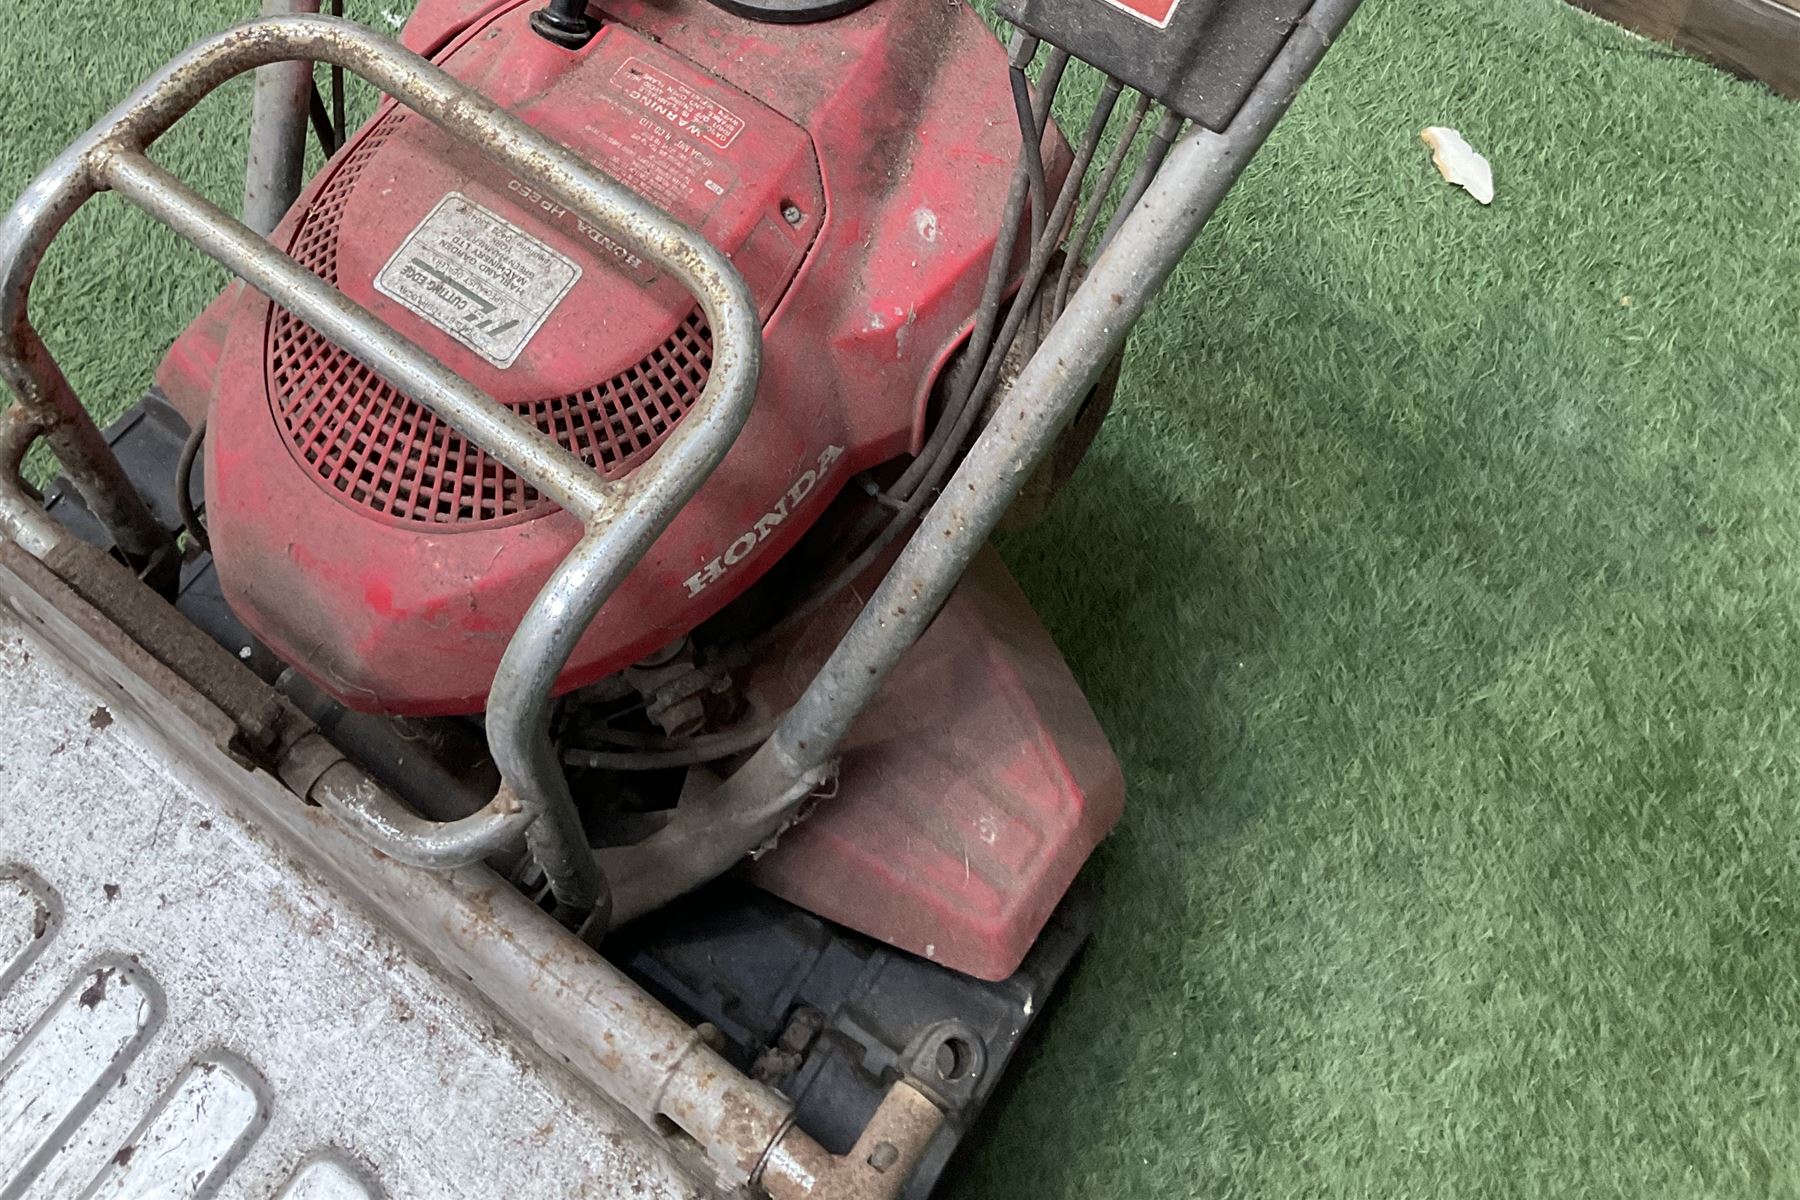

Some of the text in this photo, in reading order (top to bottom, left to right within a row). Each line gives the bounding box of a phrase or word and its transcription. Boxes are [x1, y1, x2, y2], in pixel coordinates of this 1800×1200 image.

[507, 178, 643, 268] HONDA HP250
[399, 264, 468, 311] CUTTING EDGE
[438, 237, 525, 296] HARLAND GARDEN
[470, 246, 527, 286] MACHINERY
[683, 445, 845, 598] HONDA
